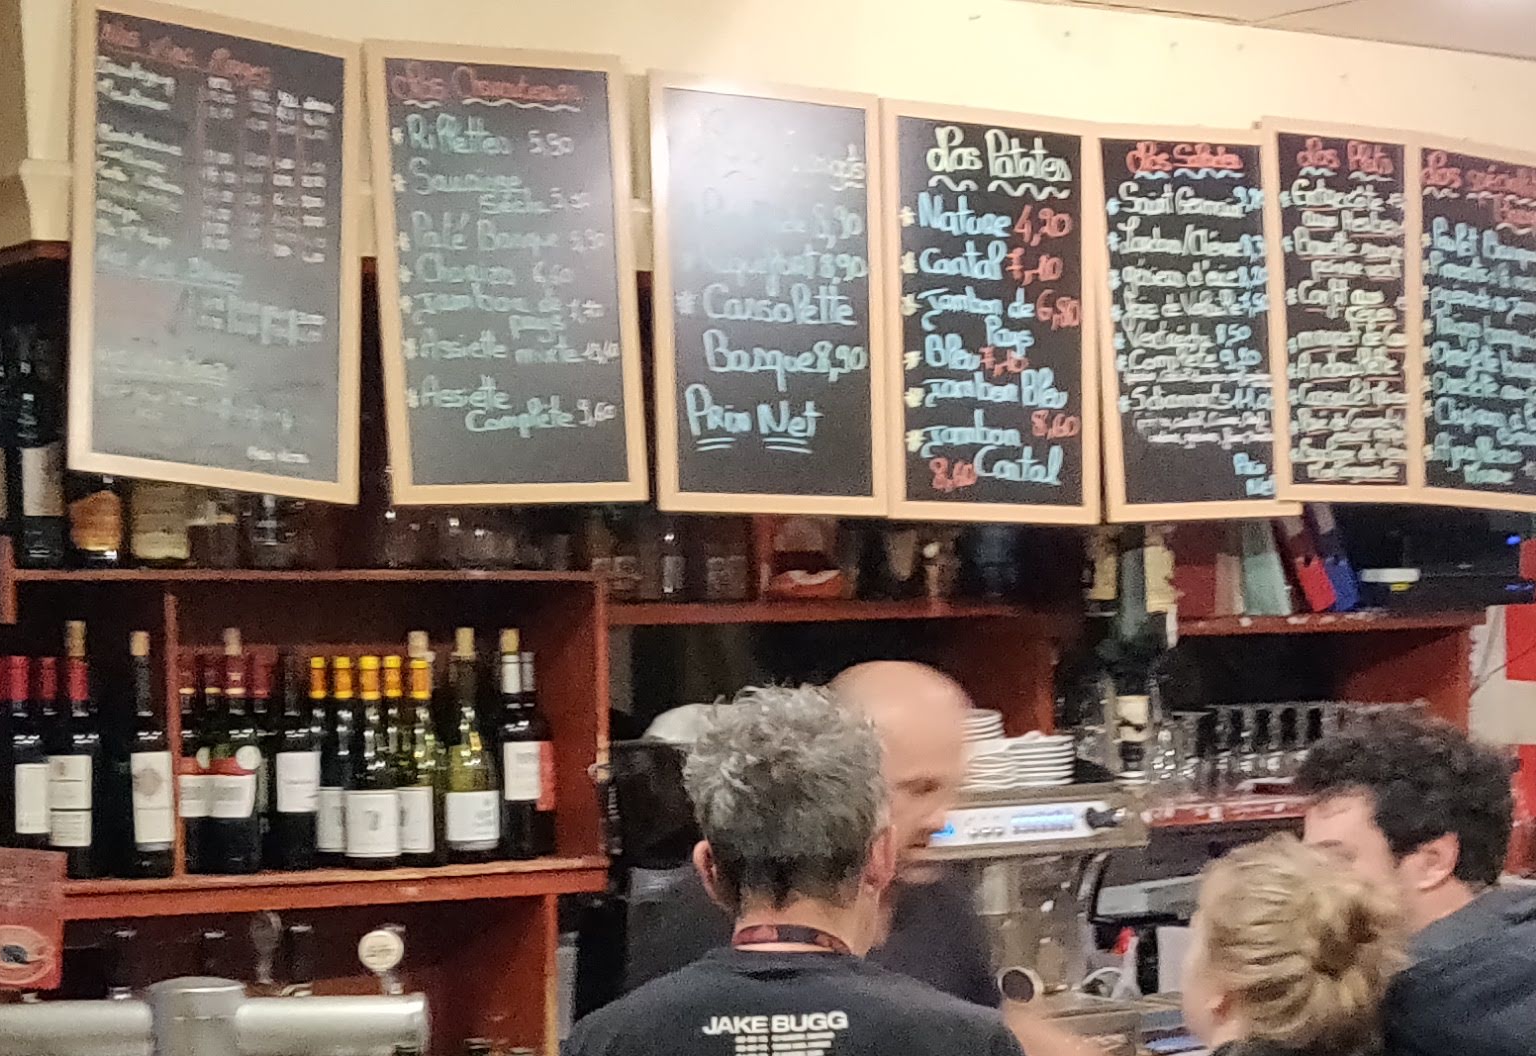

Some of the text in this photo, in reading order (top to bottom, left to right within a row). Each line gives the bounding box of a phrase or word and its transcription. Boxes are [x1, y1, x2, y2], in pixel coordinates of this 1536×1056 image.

[985, 129, 1073, 182] Patates
[918, 191, 1012, 238] Nature
[919, 240, 1008, 281] Cantal
[916, 285, 1004, 332] Jambon
[756, 399, 825, 438] Net
[973, 445, 1065, 487] Cantal
[702, 1010, 850, 1036] JAKE BUGG
